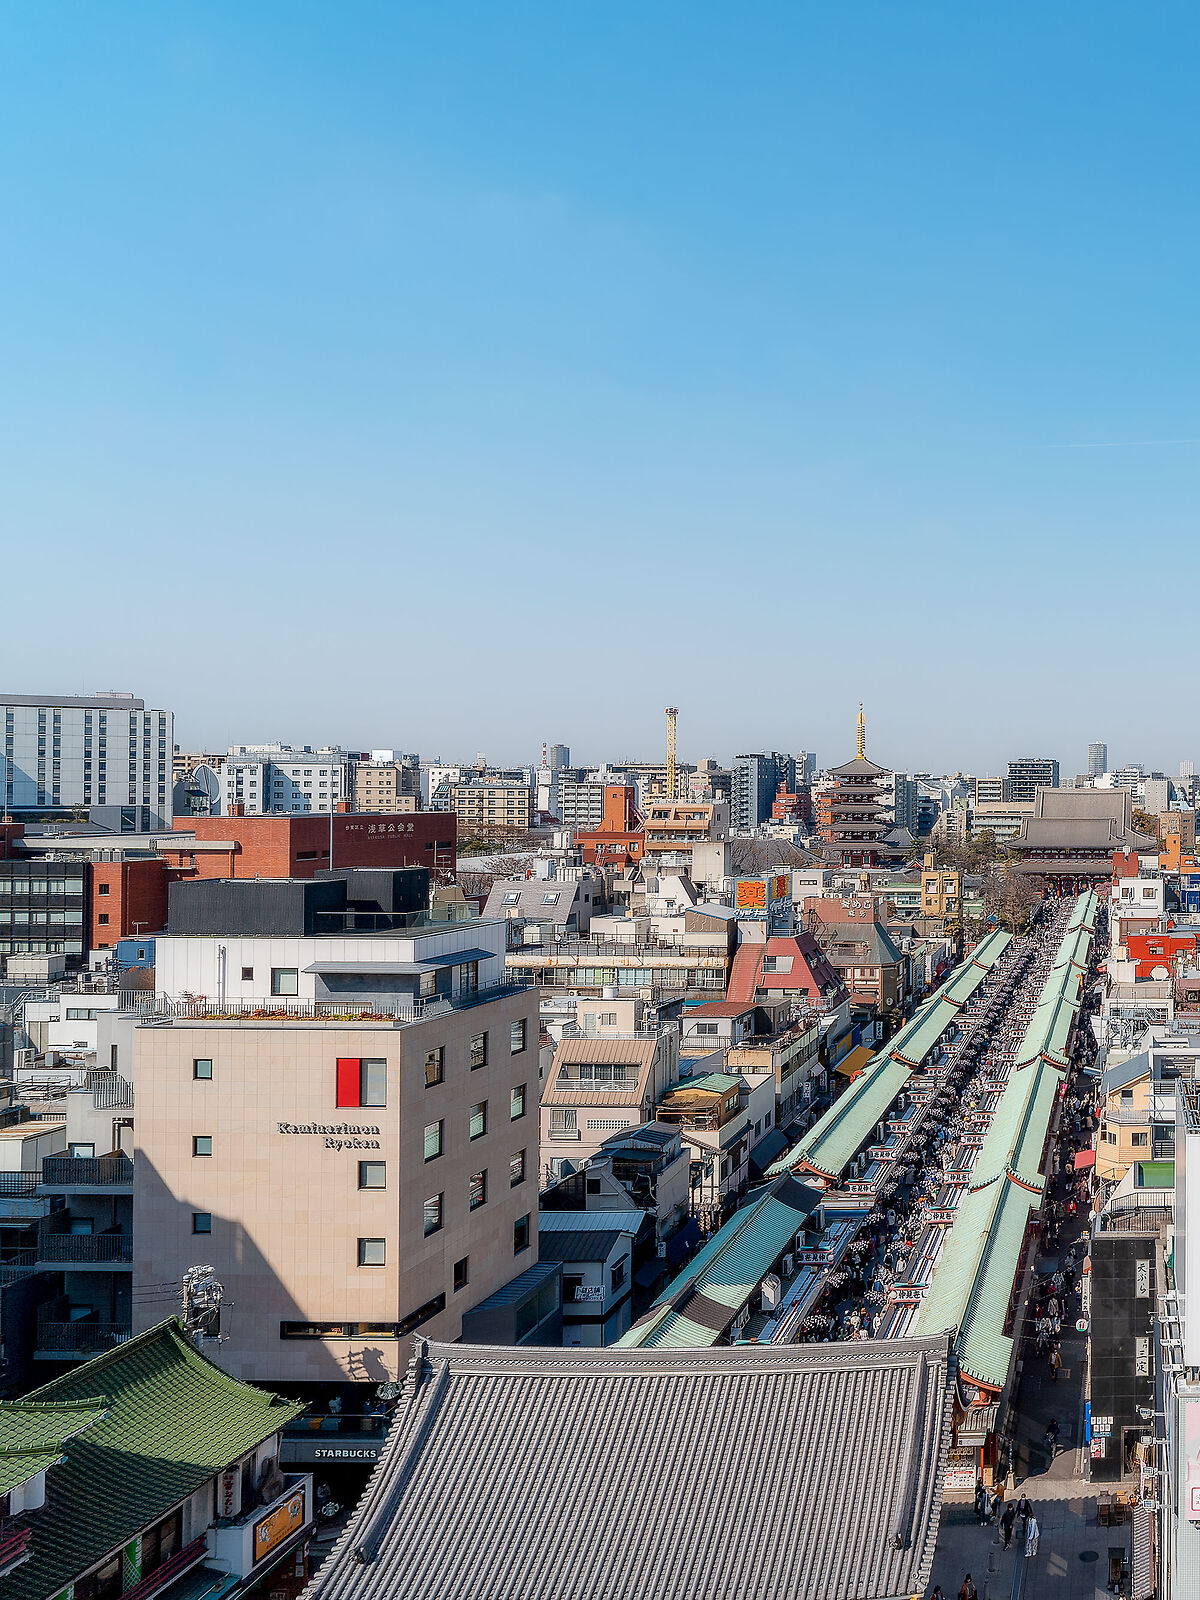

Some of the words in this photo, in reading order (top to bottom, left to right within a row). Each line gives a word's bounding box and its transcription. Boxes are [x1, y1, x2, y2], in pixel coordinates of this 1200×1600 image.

[367, 822, 415, 834] 浅草公会堂
[737, 881, 766, 907] 薬
[277, 1122, 380, 1134] Kaminarimon
[322, 1136, 380, 1152] Ryokan
[1138, 1263, 1148, 1295] 天ぷら
[315, 1449, 377, 1458] STARBUCKS
